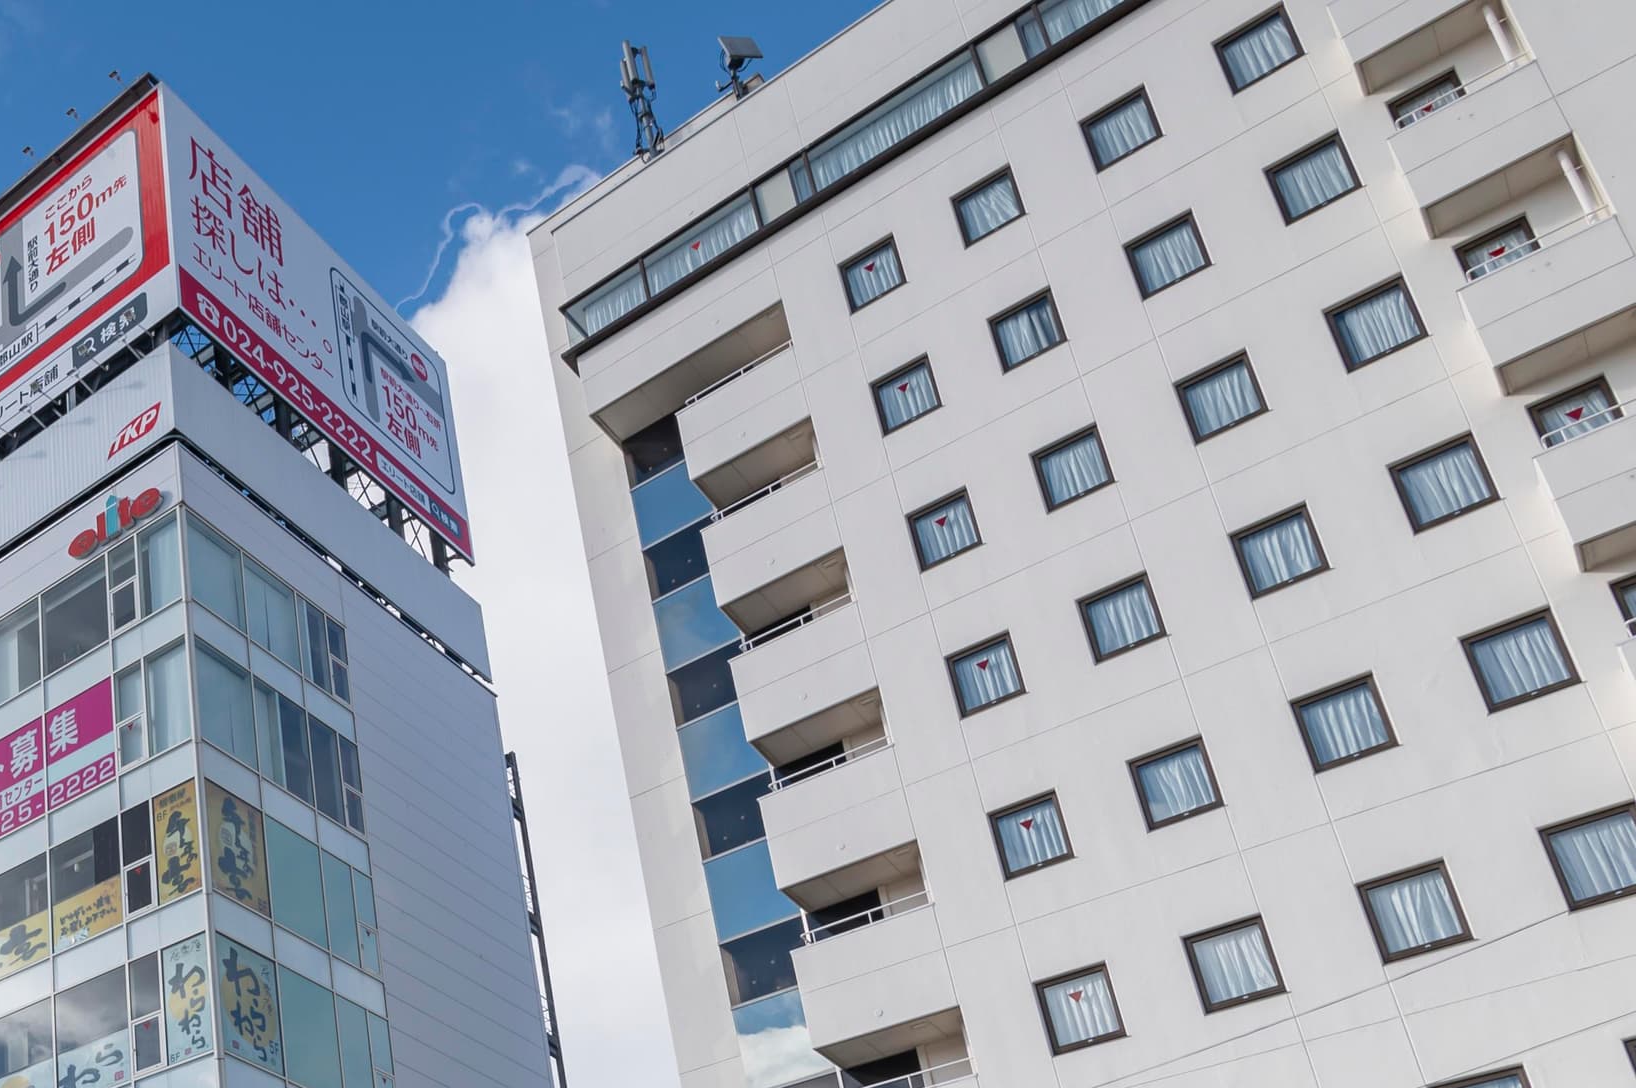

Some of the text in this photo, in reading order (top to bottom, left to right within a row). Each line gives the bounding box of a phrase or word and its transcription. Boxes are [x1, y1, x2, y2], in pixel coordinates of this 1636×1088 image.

[44, 174, 127, 246] 150m先
[45, 175, 93, 220] ここから
[189, 136, 284, 267] 店舗
[27, 235, 39, 293] 駅前大通り
[45, 217, 95, 277] 左側
[193, 242, 334, 378] エリート店舗センター
[223, 316, 373, 464] 024-925-2222
[381, 385, 440, 452] 150m先
[111, 406, 158, 456] TKP
[385, 412, 422, 460] 左側
[67, 487, 162, 559] elite
[168, 962, 206, 1049] わらわら
[223, 946, 267, 1062] わらわら
